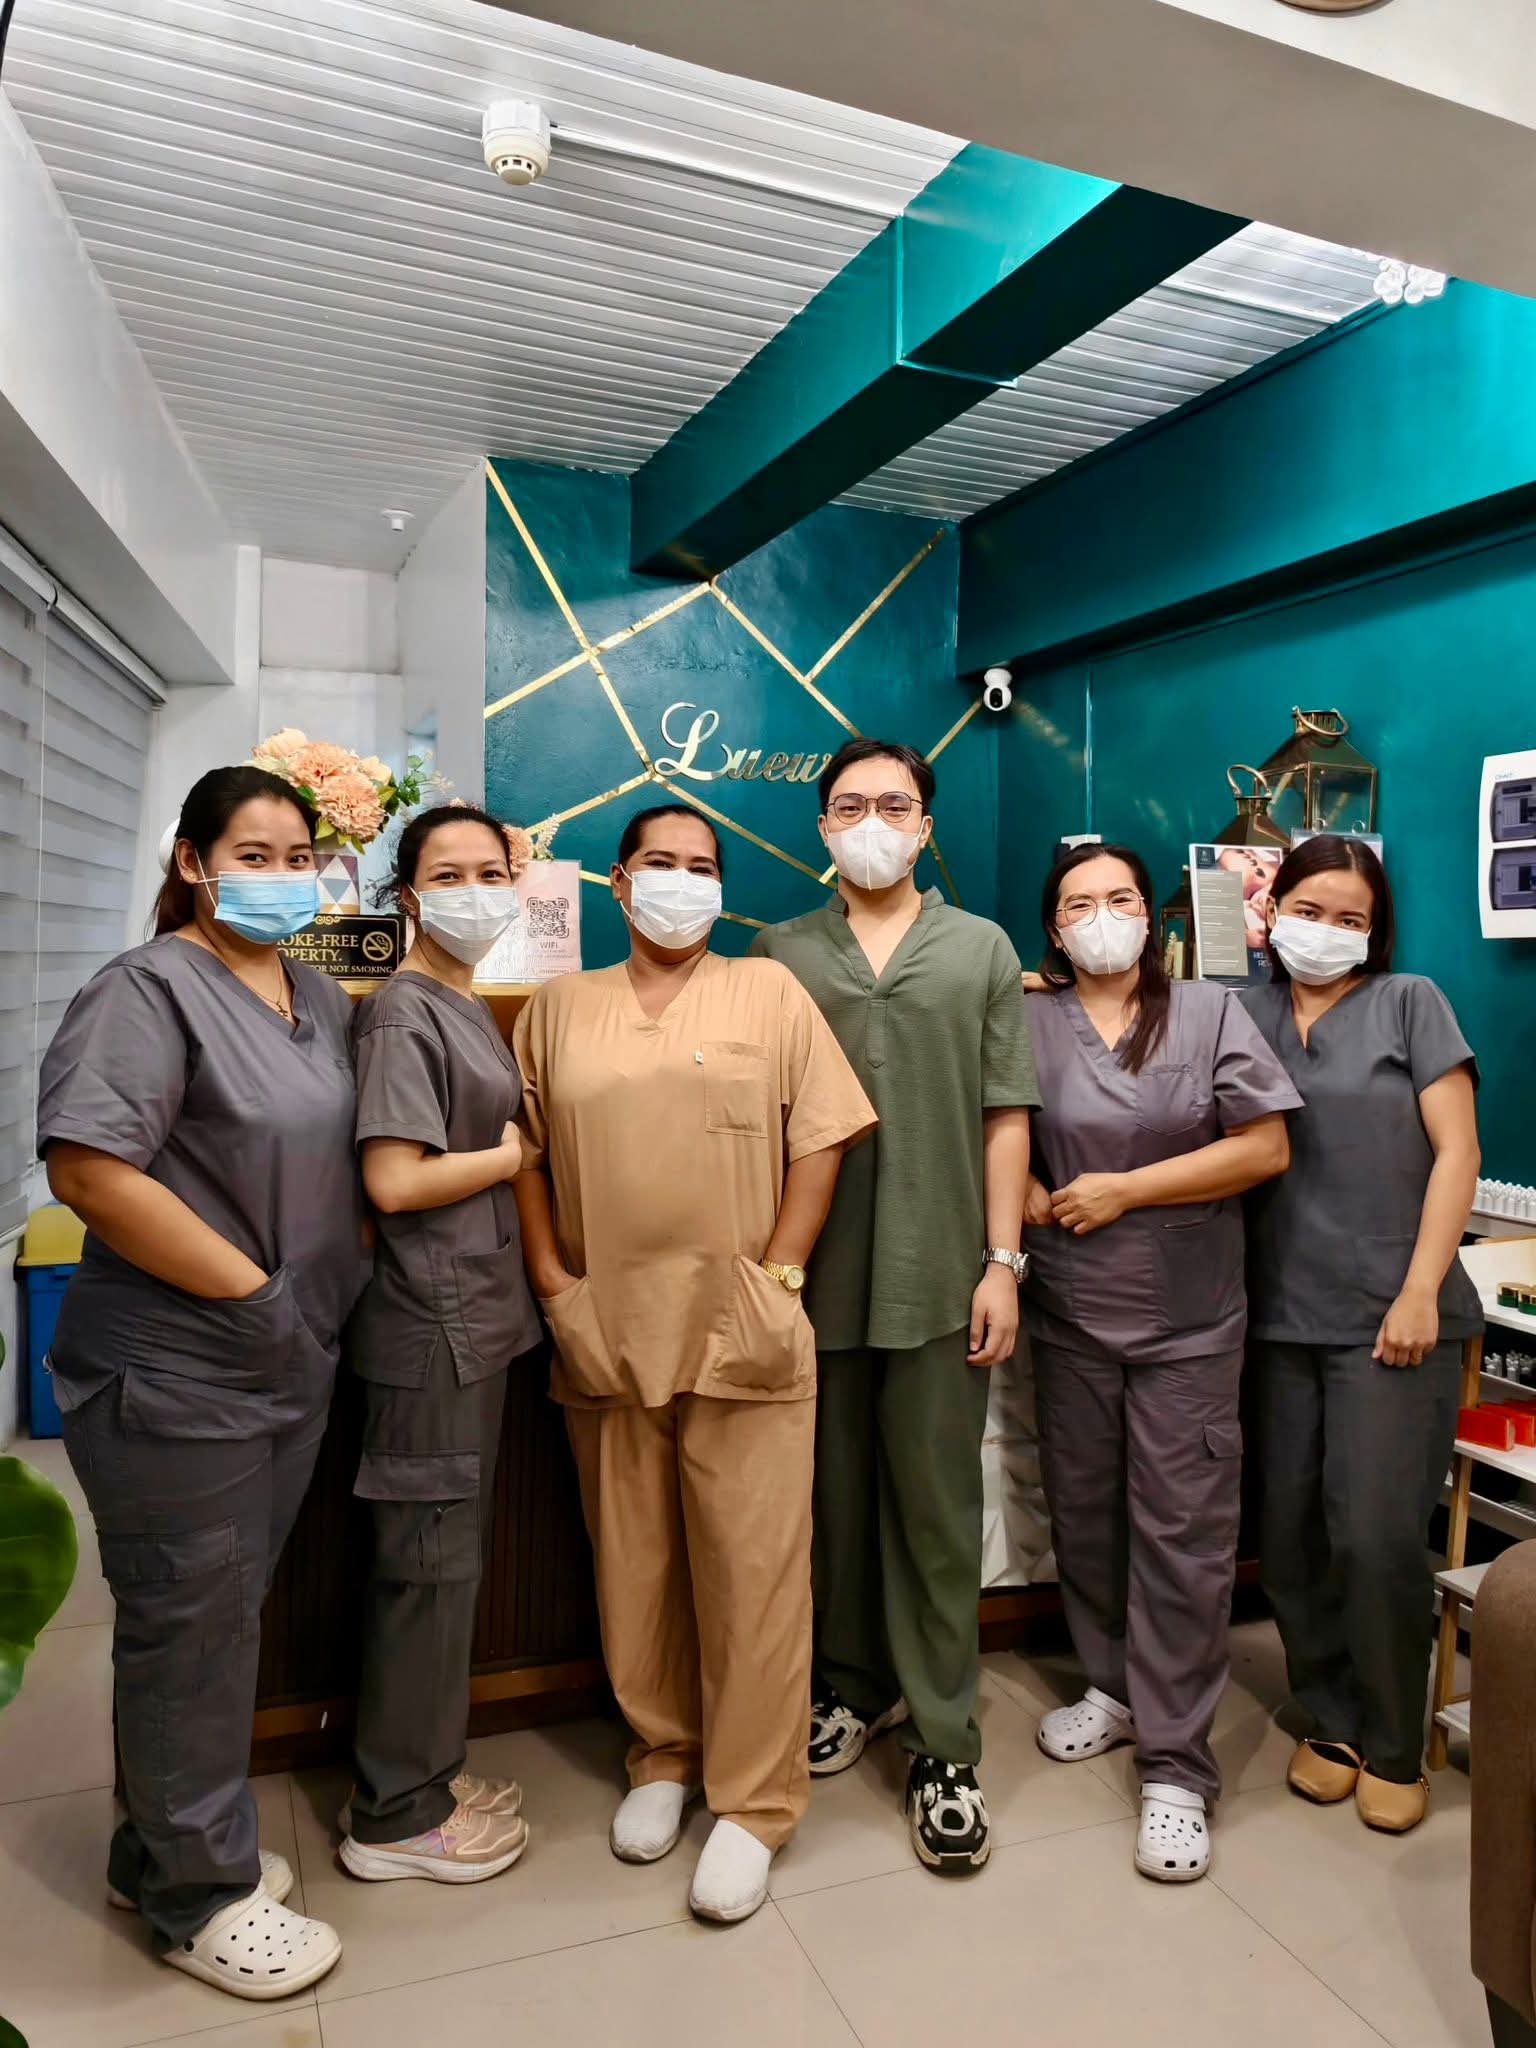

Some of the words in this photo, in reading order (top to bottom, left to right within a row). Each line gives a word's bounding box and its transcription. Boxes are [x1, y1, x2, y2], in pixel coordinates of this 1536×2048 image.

[277, 933, 359, 947] OKE-FREE
[277, 948, 342, 961] OPERTY.
[330, 964, 349, 972] NOT
[351, 965, 393, 973] SMOKING
